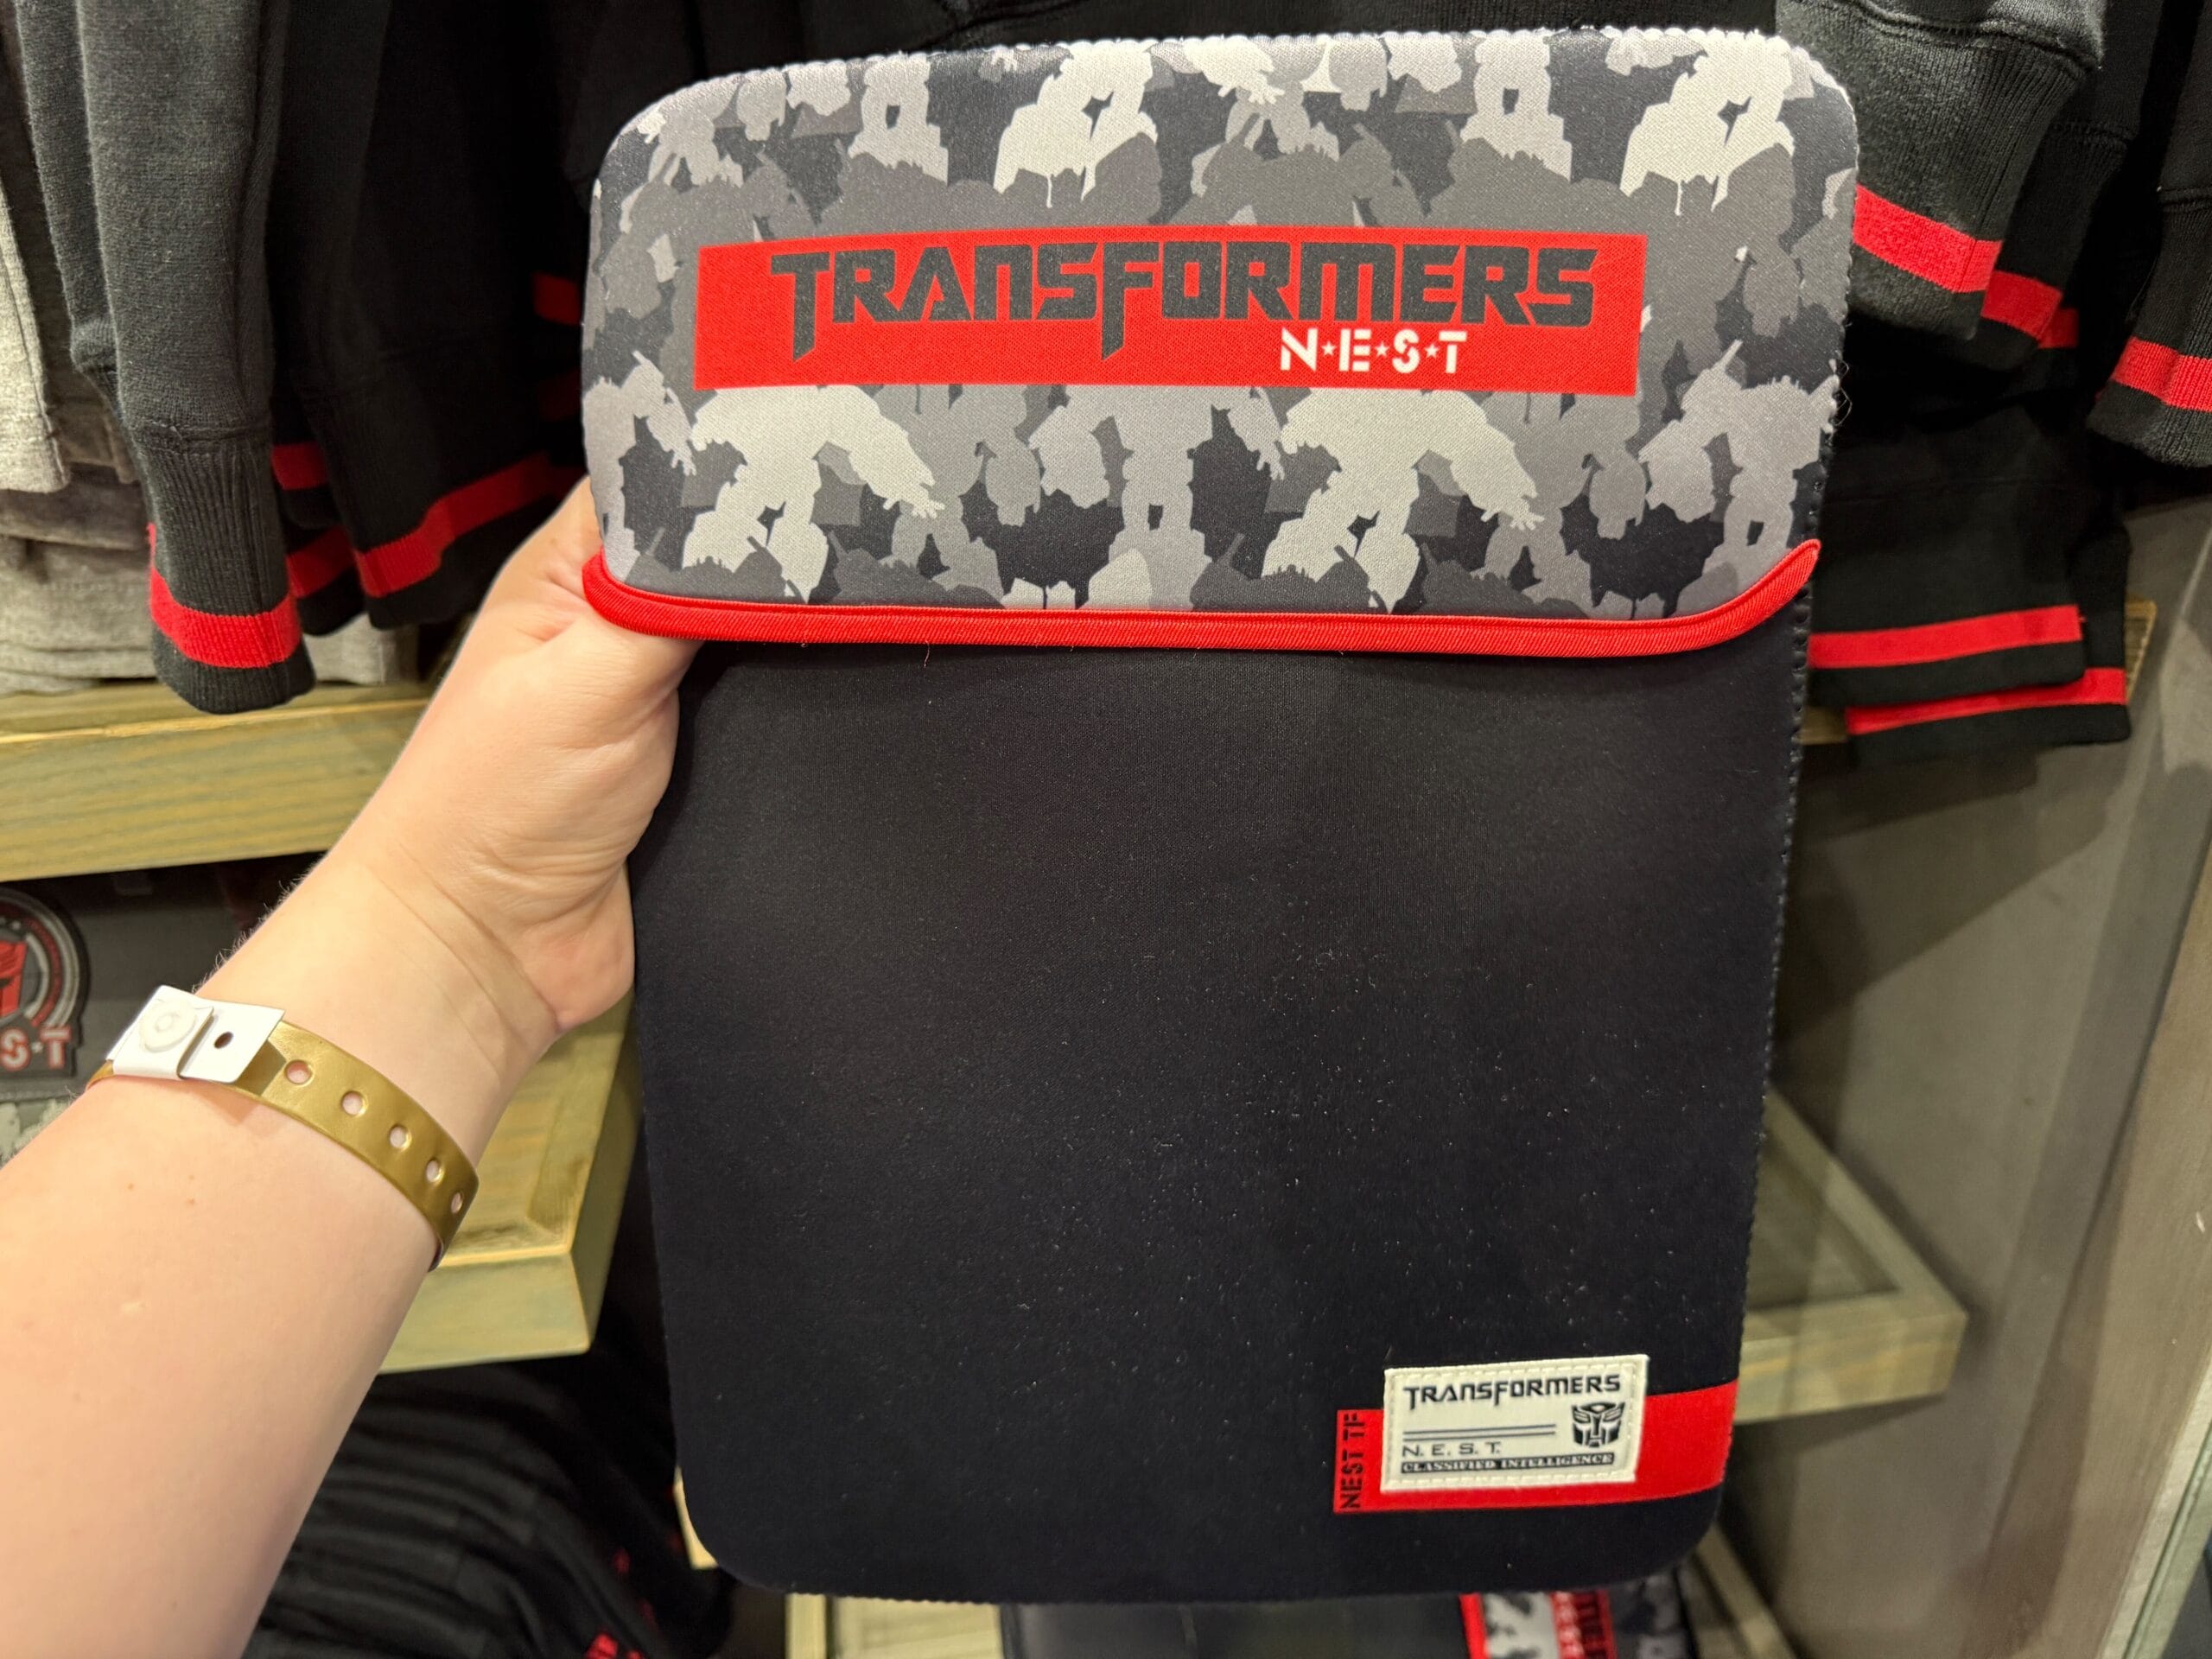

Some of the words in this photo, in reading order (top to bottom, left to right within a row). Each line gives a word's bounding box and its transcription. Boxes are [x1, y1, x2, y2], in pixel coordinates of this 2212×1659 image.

[770, 238, 1599, 362] TRANSFORMERS
[1402, 1374, 1621, 1410] TRANSFORMERS
[1343, 1413, 1365, 1441] TF
[1340, 1449, 1364, 1509] NEST
[1402, 1459, 1497, 1472] CLASSIFIED
[1501, 1453, 1614, 1468] INTELLIGENCE
